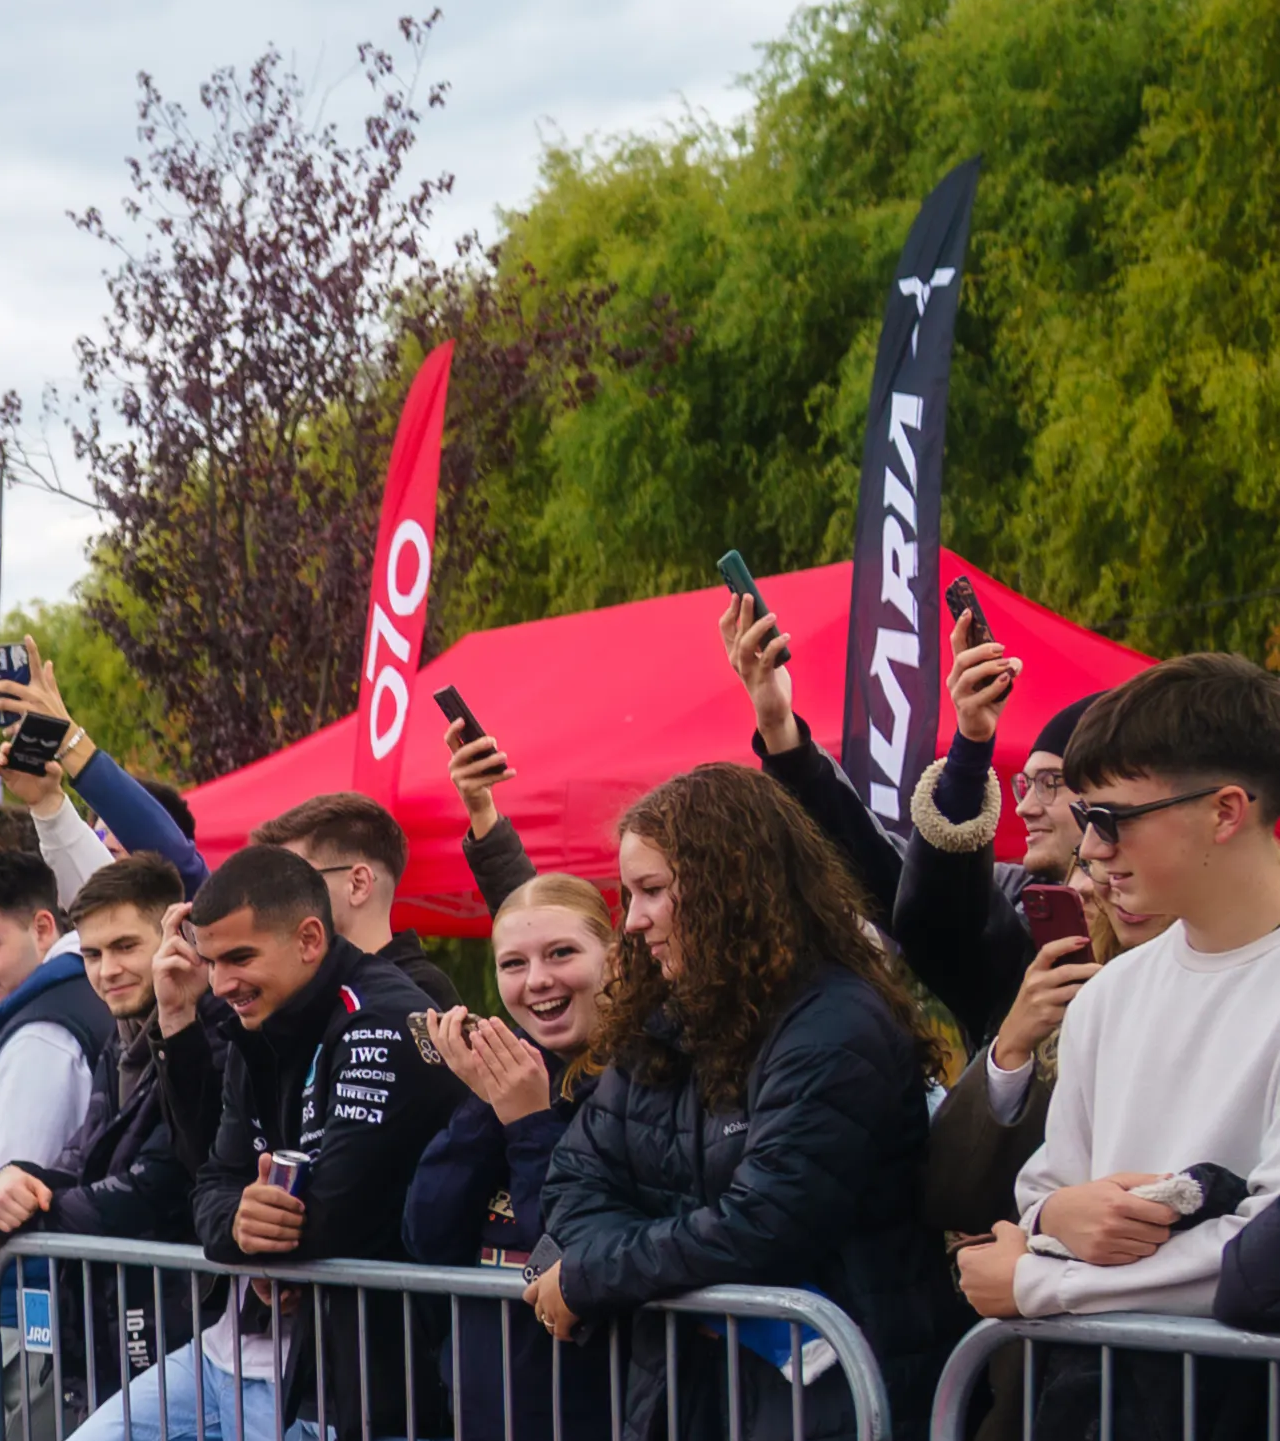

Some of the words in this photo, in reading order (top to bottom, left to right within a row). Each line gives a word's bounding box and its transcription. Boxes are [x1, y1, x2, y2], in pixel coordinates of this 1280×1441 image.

[350, 1046, 388, 1064] IWC
[336, 1082, 389, 1104] PIRELLI
[334, 1103, 367, 1120] AMD
